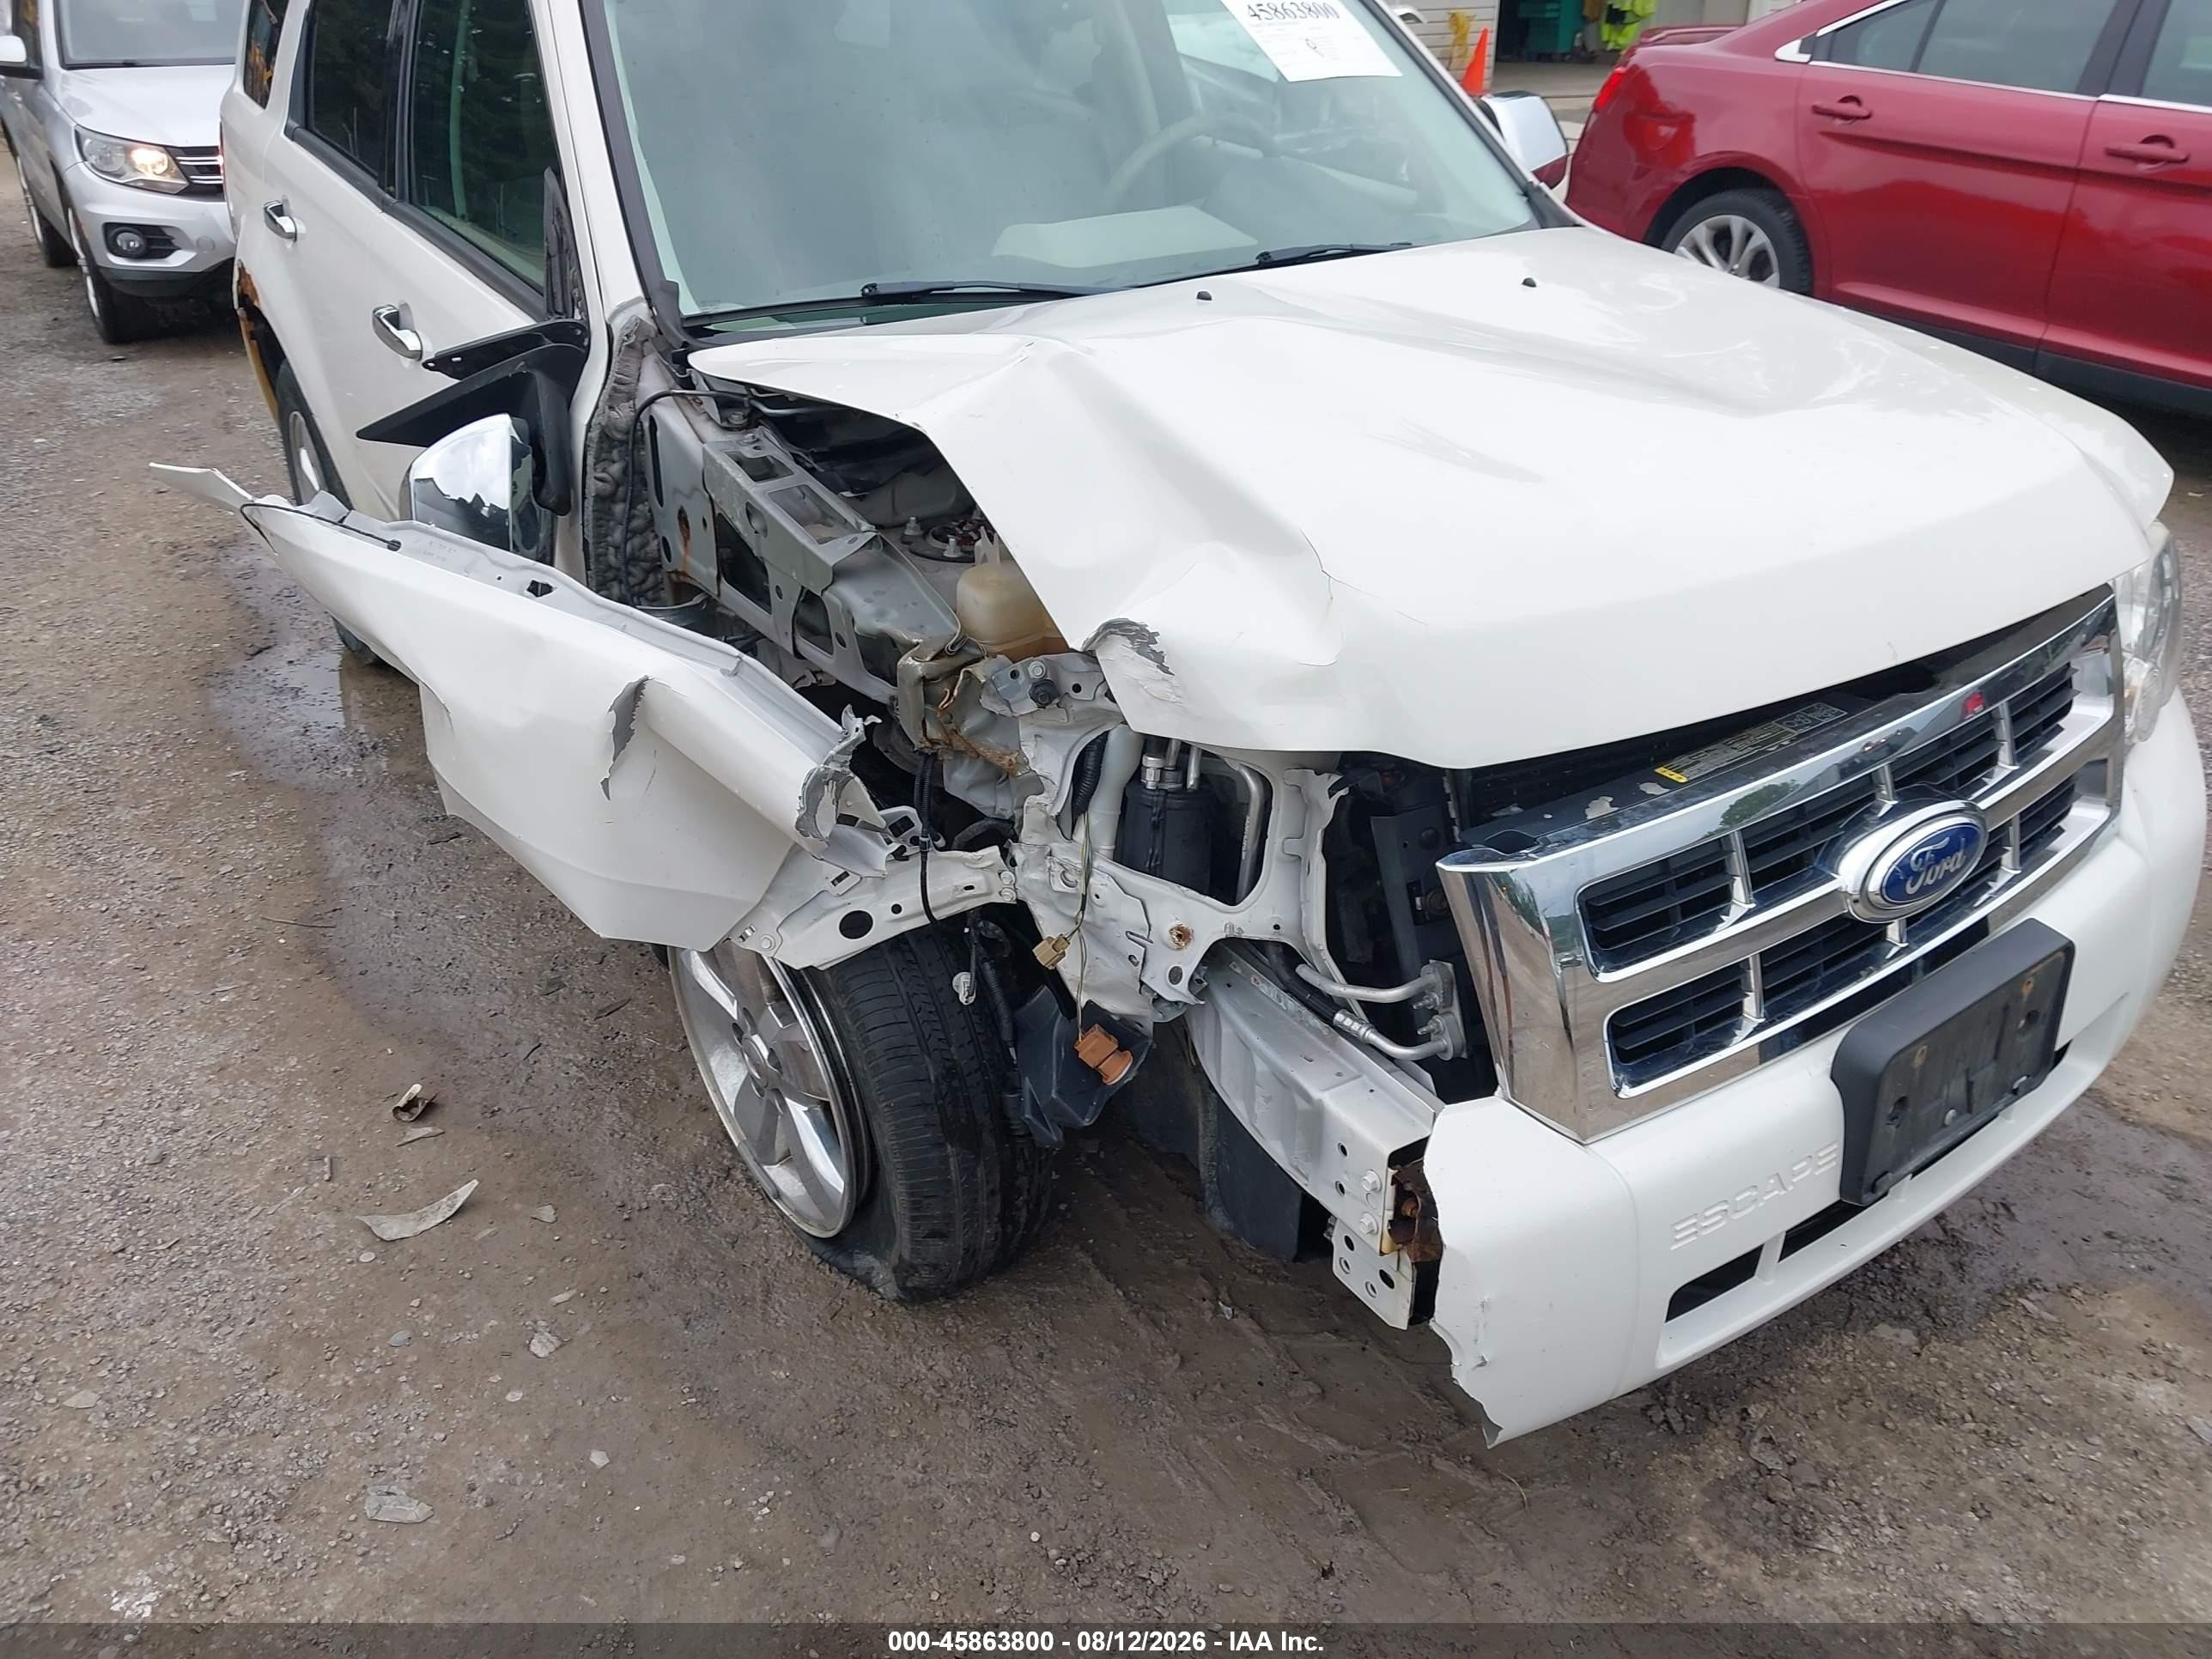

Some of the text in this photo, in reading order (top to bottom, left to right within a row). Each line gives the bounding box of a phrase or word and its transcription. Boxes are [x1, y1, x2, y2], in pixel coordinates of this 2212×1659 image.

[1247, 1, 1340, 21] 45863800
[1904, 836, 1966, 895] Ford
[1670, 1140, 1838, 1251] ESCAPE
